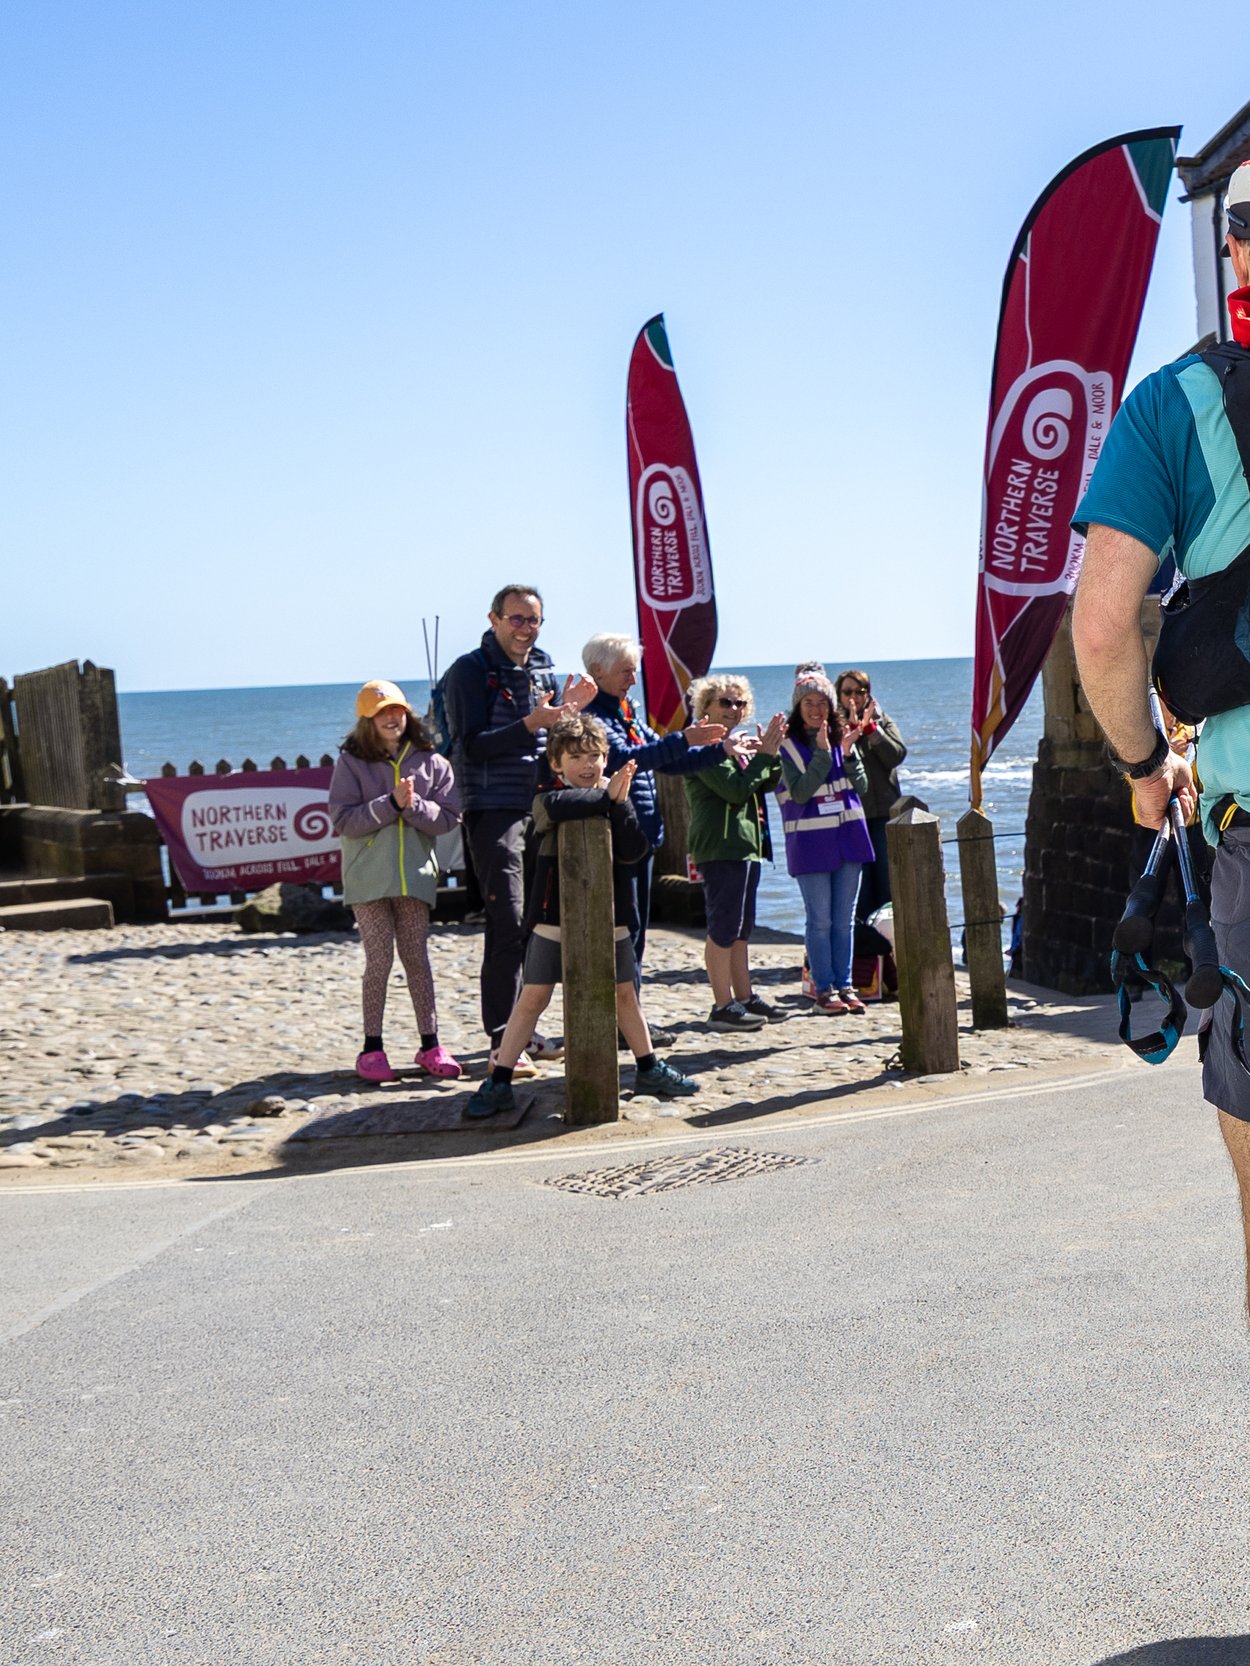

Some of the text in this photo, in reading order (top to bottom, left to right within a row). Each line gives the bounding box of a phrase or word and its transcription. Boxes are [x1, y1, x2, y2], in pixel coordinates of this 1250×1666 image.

[1092, 382, 1105, 415] MOOR
[1088, 434, 1101, 460] DALE
[991, 458, 1033, 570] NORTHERN
[1020, 467, 1060, 572] TRAVERSE
[651, 527, 665, 596] NORTHERN
[664, 530, 682, 594] TRAVERSE
[192, 803, 287, 827] NORTHERN
[196, 825, 287, 851] TRAVERSE
